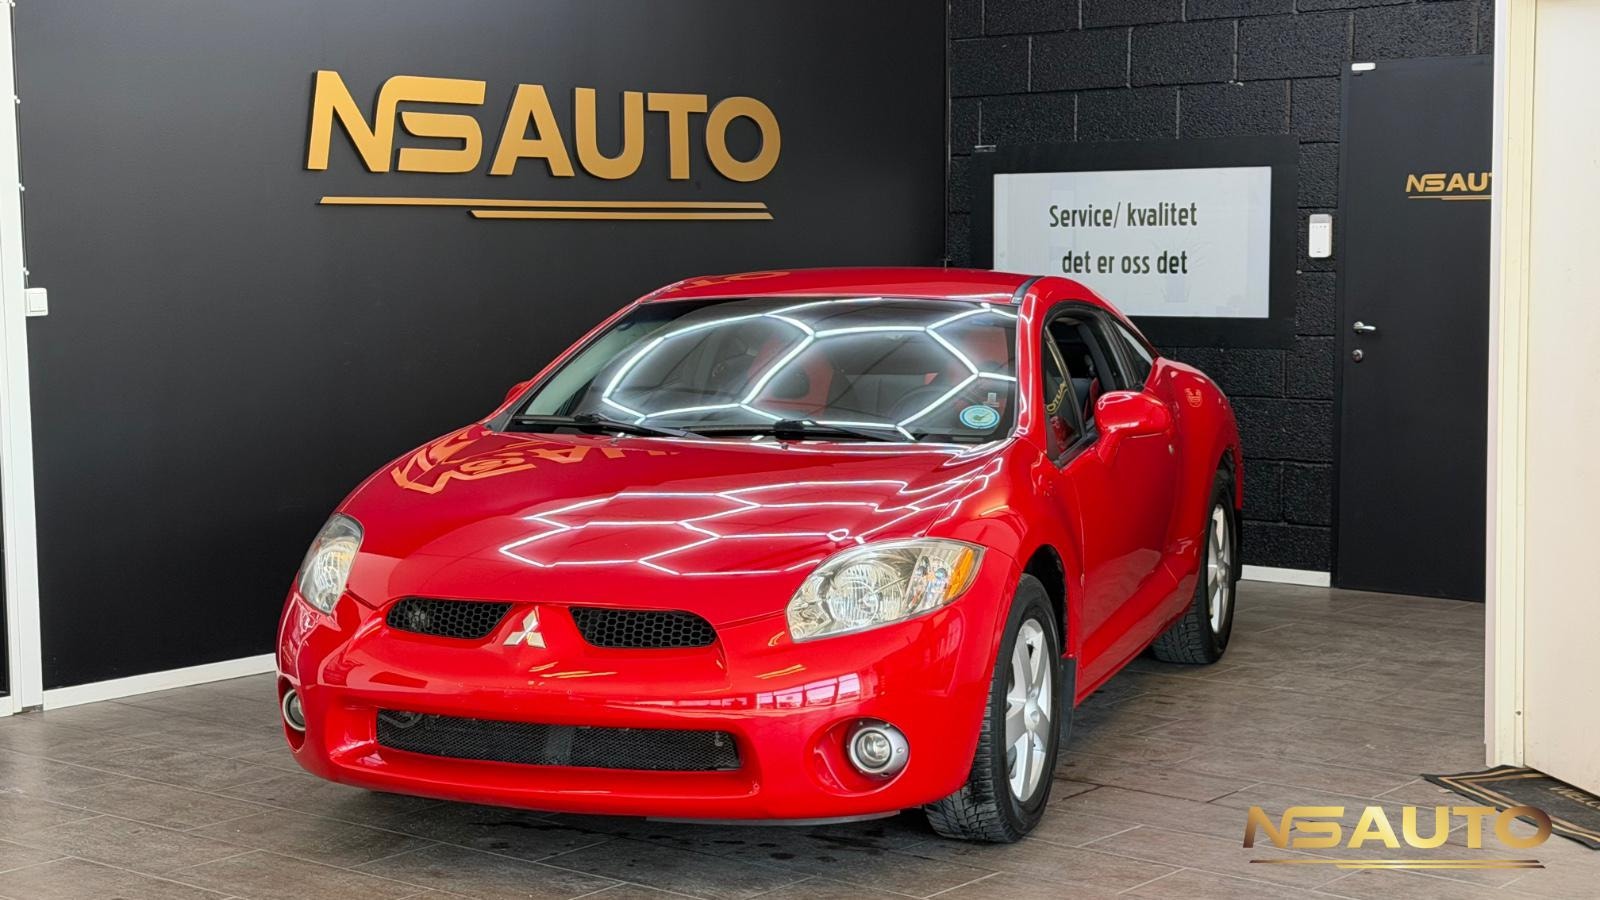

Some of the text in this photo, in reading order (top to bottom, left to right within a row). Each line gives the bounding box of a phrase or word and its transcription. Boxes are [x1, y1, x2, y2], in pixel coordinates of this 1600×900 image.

[306, 69, 781, 182] NSAUTO
[1405, 172, 1491, 193] NSAU
[1049, 202, 1197, 228] Service/ kvalitet
[1062, 251, 1188, 275] det er oss det
